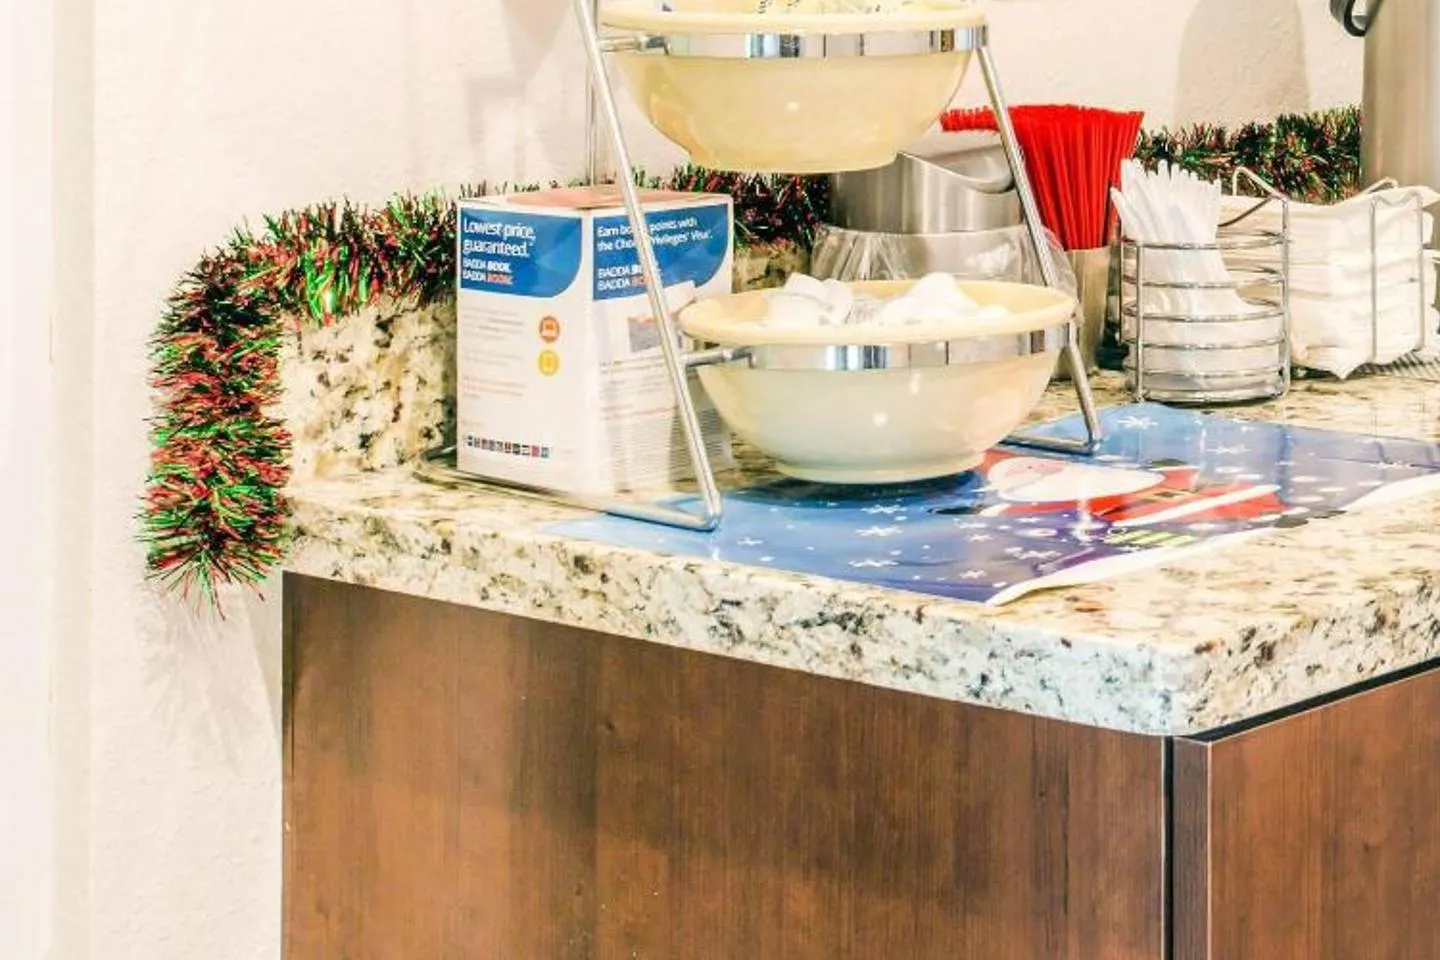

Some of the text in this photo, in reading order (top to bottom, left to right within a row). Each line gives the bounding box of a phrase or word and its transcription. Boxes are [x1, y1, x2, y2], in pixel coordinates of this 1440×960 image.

[463, 217, 502, 236] Lowest
[597, 226, 619, 238] Earn
[597, 242, 613, 252] the
